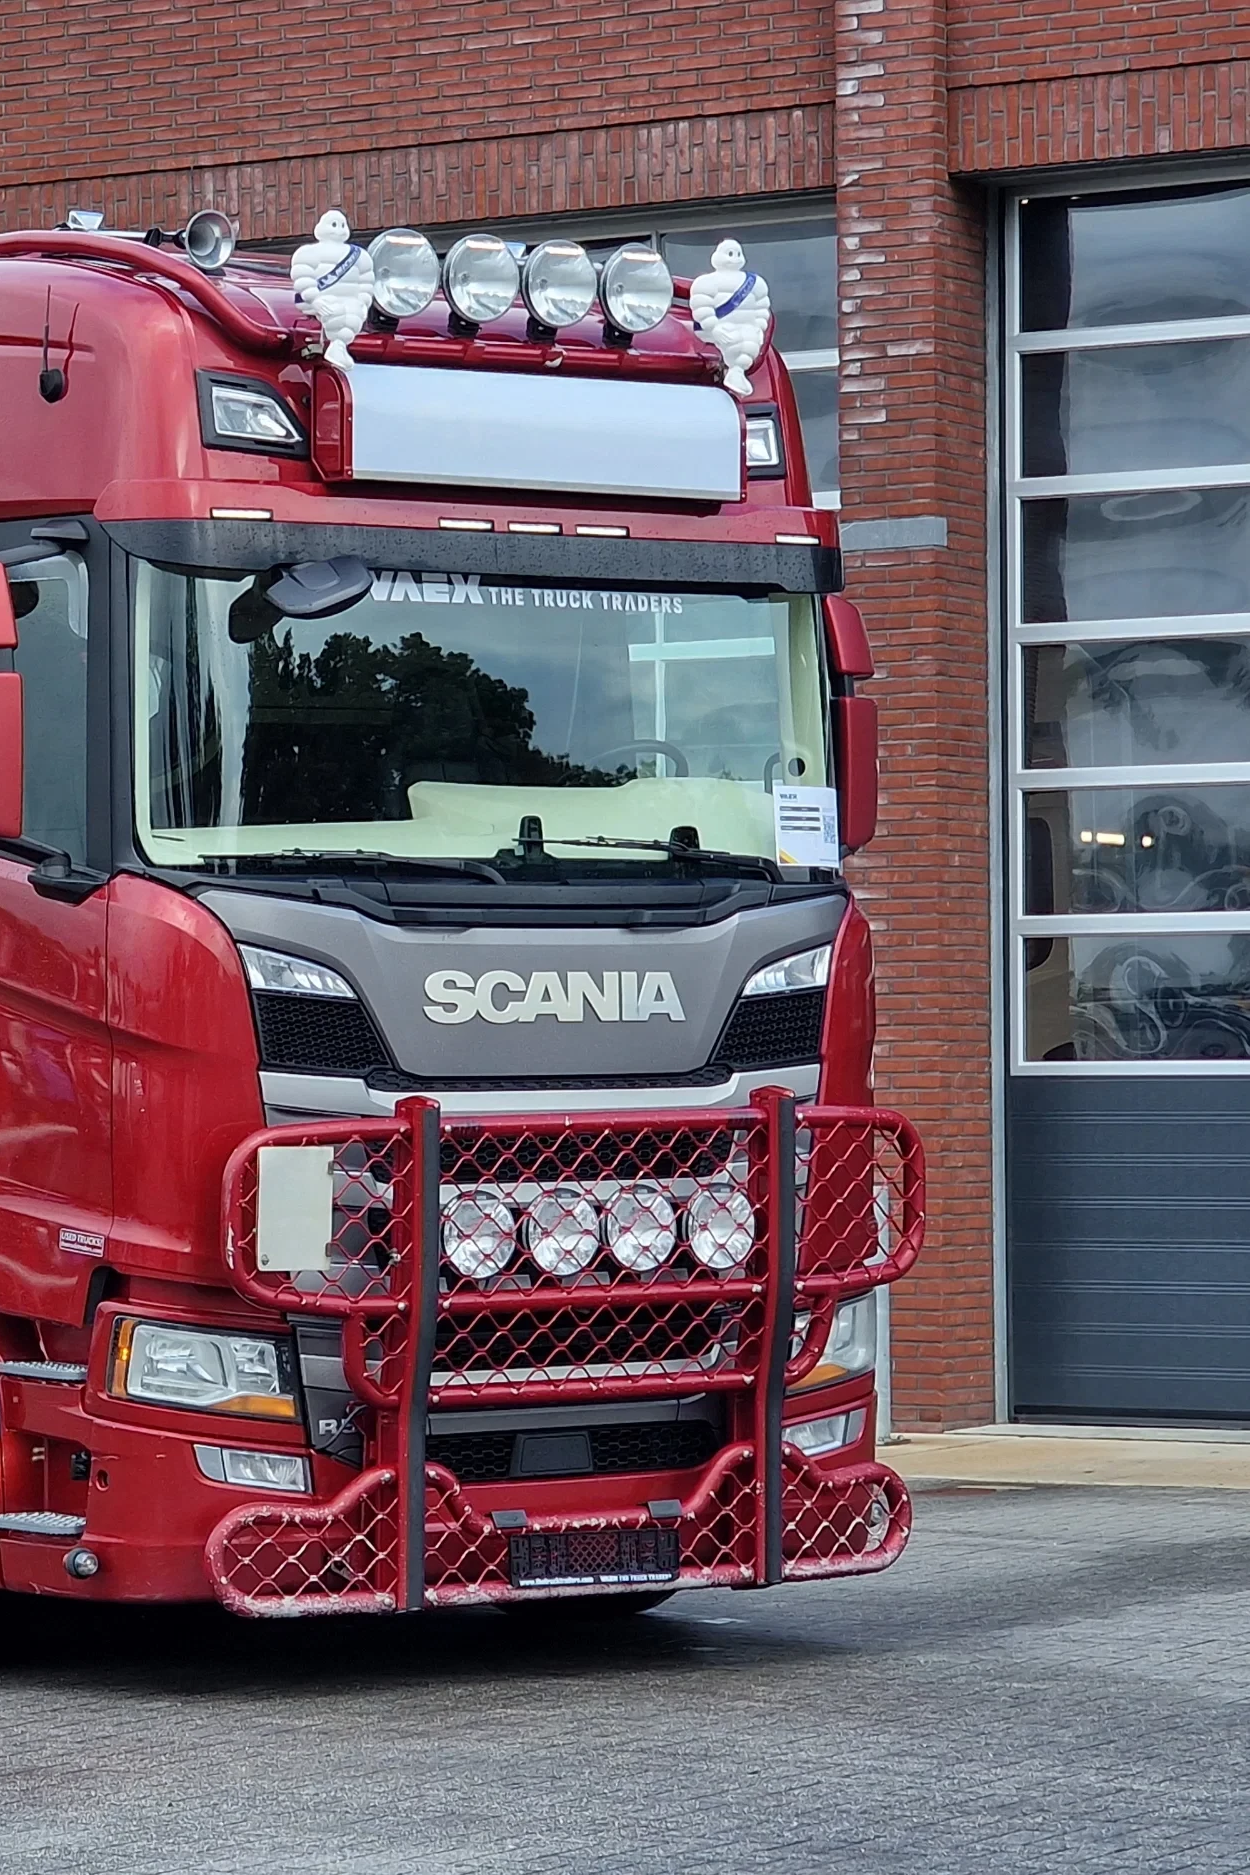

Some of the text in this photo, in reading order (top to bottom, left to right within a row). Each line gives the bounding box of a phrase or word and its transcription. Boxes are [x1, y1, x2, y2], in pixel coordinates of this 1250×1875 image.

[369, 570, 682, 614] VAEX THE TRUCK TRADERS
[422, 970, 686, 1025] SCANIA
